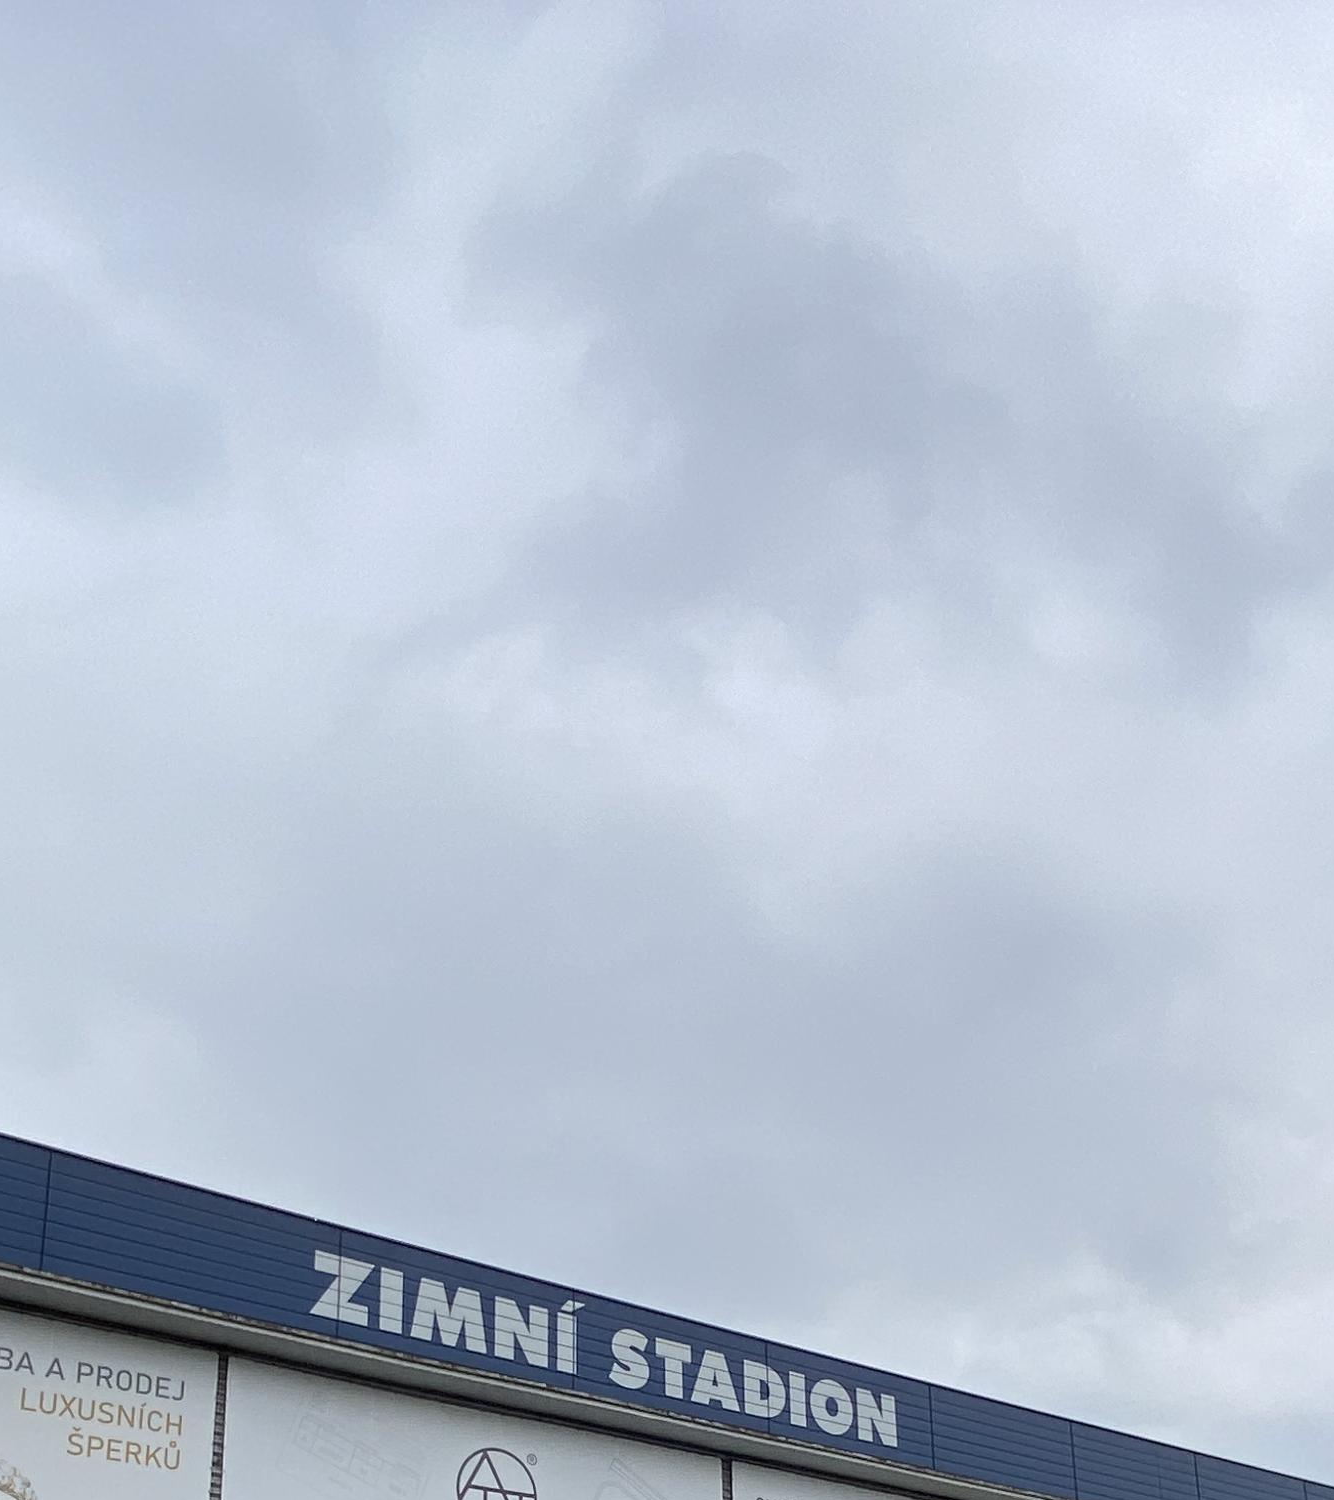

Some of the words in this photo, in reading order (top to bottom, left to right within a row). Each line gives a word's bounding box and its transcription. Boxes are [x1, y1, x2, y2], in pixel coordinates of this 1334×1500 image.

[308, 1249, 585, 1376] ZIMNÍ
[608, 1328, 898, 1447] STADION
[45, 1357, 65, 1381] A
[77, 1362, 186, 1401] PRODEJ
[20, 1388, 183, 1436] LUXUSNÍCH
[67, 1427, 181, 1470] ŠPERKŮ
